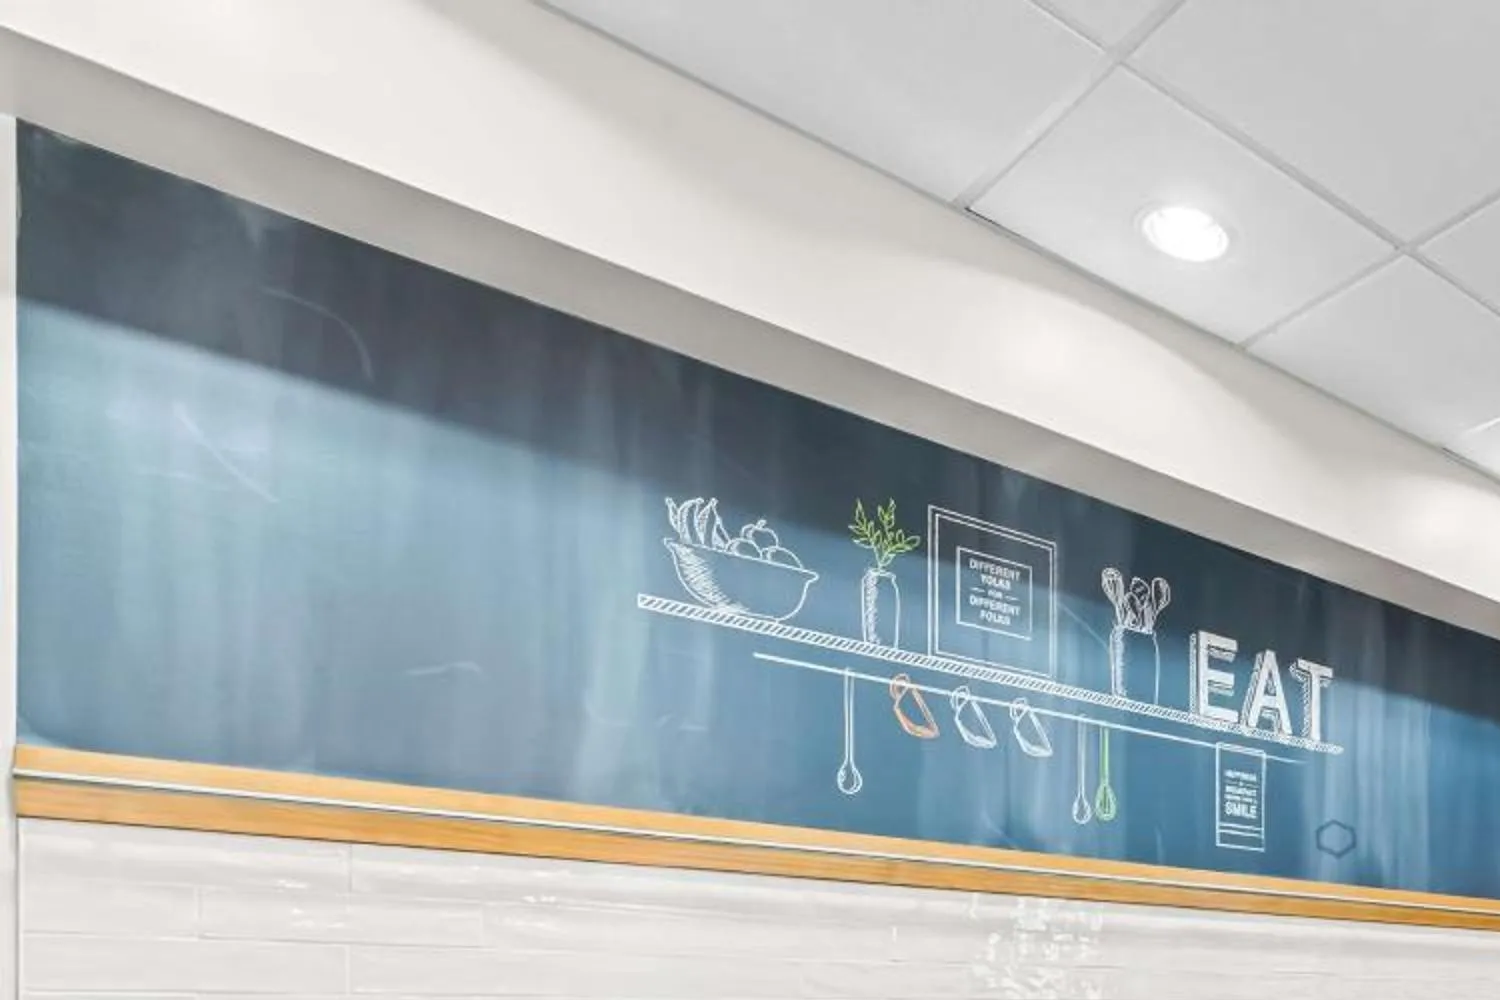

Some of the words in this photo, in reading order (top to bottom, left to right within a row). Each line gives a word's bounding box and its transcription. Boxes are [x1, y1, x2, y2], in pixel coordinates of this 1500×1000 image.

[969, 558, 1021, 581] DIFFERENT
[969, 594, 1021, 617] DIFFERENT
[1189, 630, 1334, 741] EAT
[1224, 801, 1257, 819] SMILE
